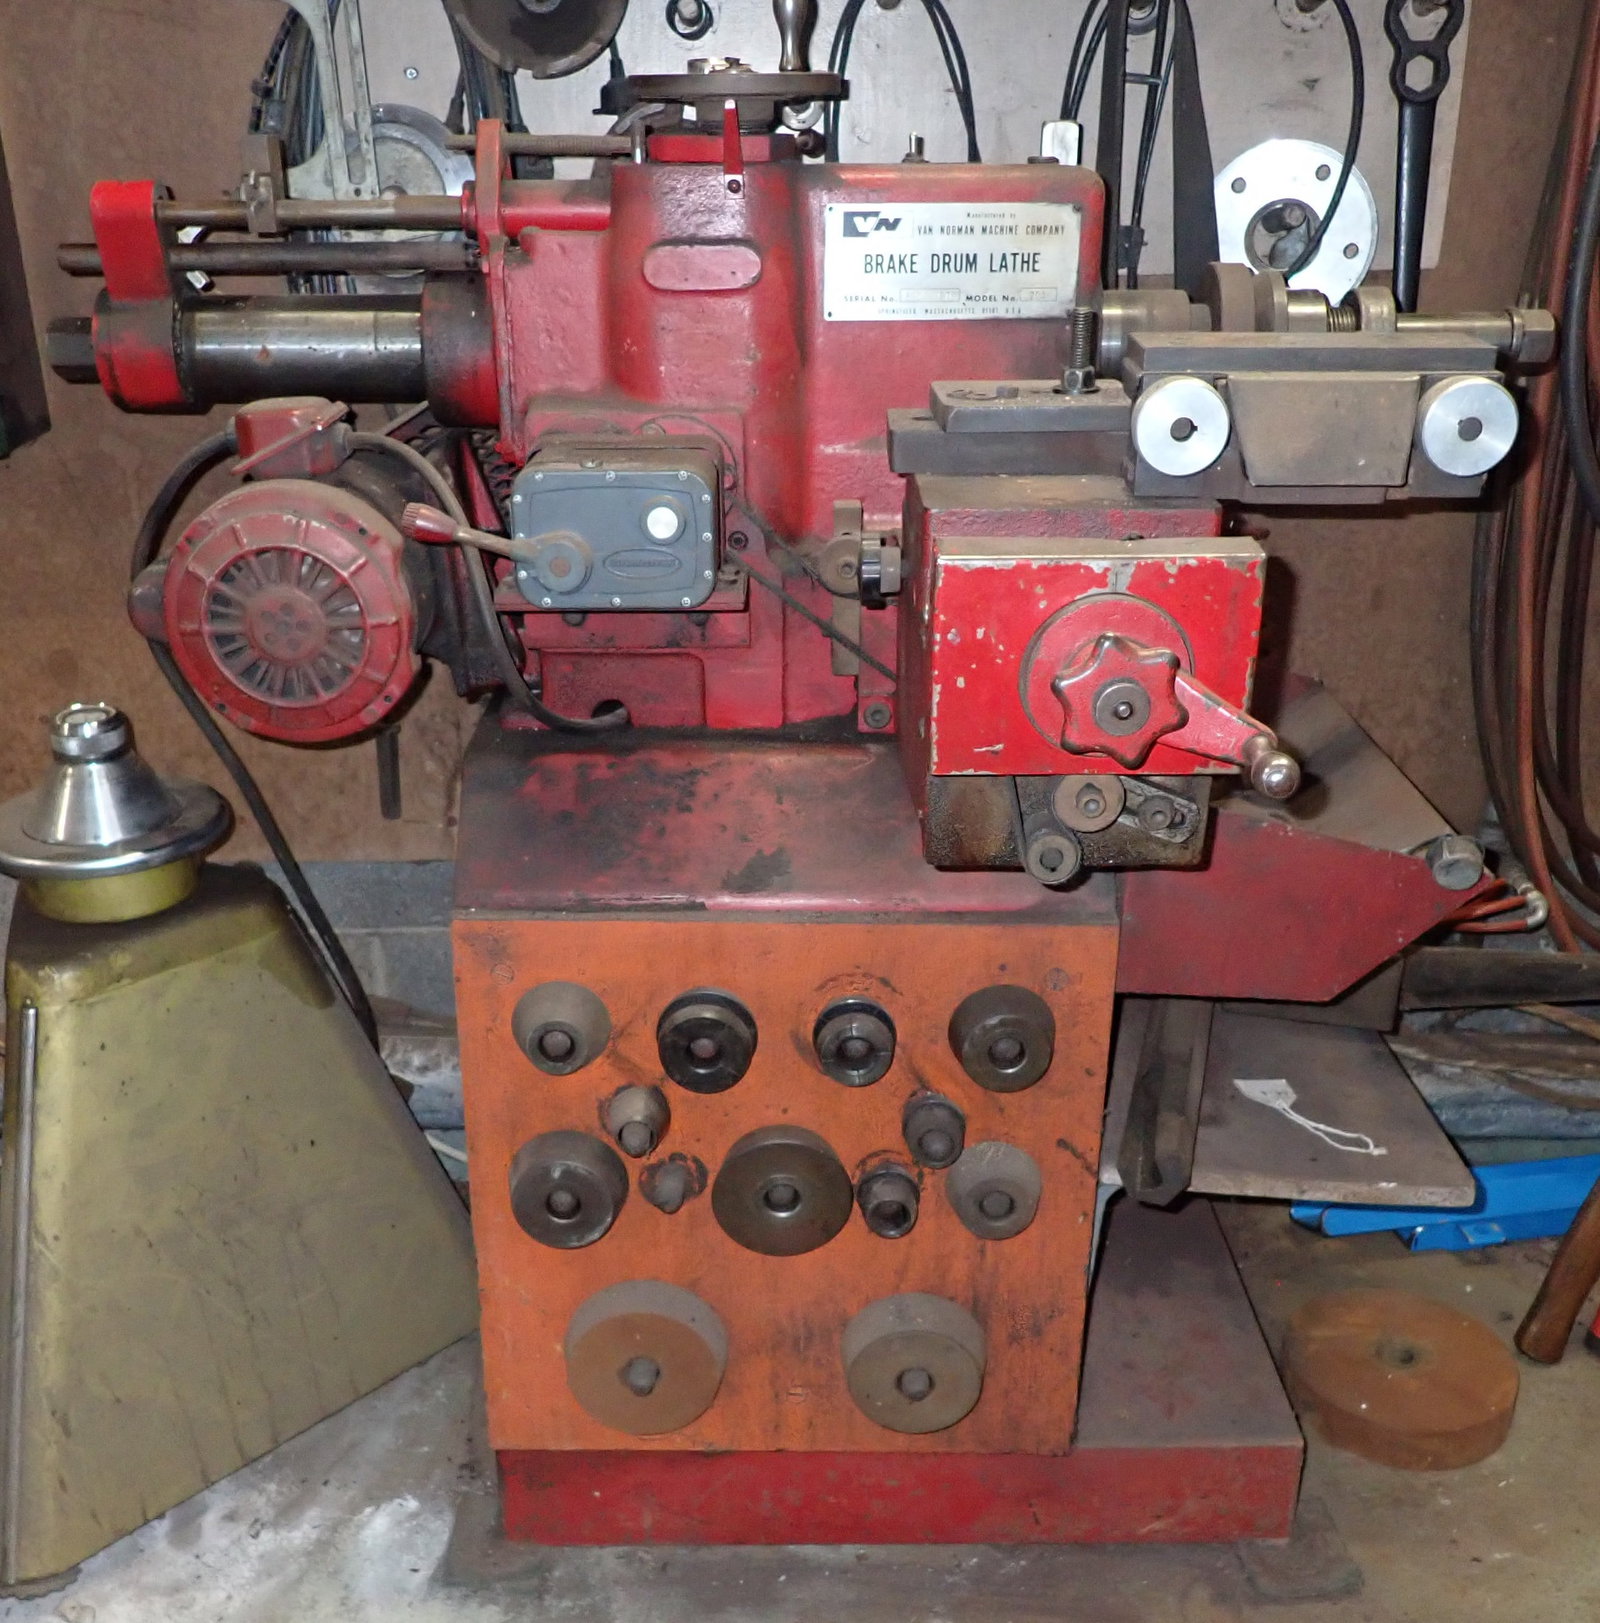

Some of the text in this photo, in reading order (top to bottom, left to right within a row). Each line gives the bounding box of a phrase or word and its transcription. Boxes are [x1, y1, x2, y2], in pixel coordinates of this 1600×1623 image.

[917, 224, 1066, 236] VAN NORMAN MACHINE COMPANY
[864, 252, 1041, 274] BRAKE DRUM LATHE
[965, 294, 998, 302] MODEL
